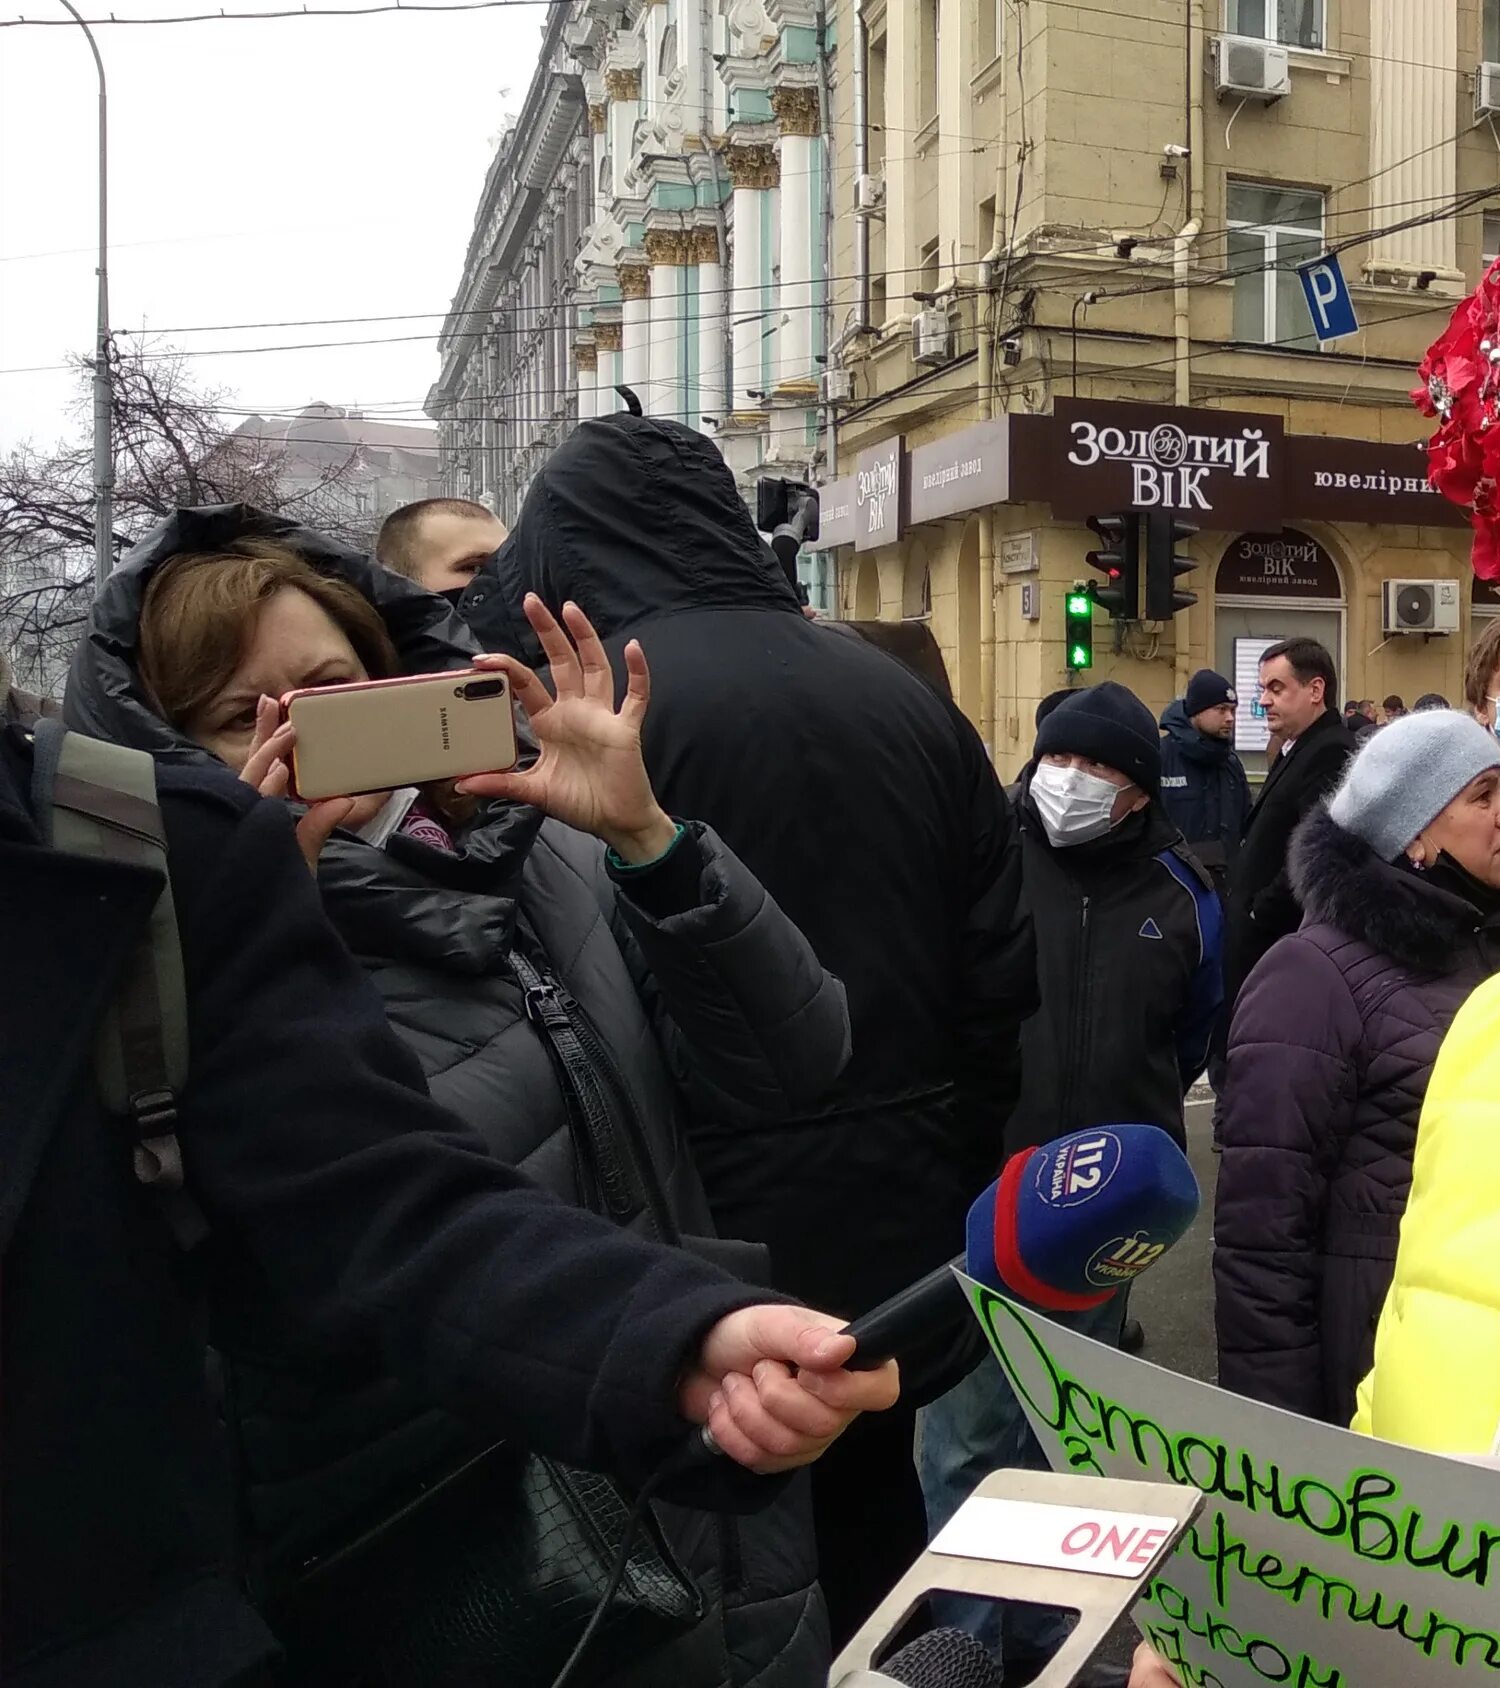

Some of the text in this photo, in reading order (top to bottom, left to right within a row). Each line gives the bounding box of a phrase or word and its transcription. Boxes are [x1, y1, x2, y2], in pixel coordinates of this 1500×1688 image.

[1308, 264, 1338, 329] P
[1314, 469, 1442, 495] ювелірни
[1023, 591, 1031, 611] 5
[440, 707, 450, 750] SAMSUNG
[1051, 1145, 1071, 1200] УКРАЇНА
[1070, 1137, 1107, 1193] 112
[1111, 1238, 1165, 1265] 112
[1061, 1522, 1168, 1564] ONE
